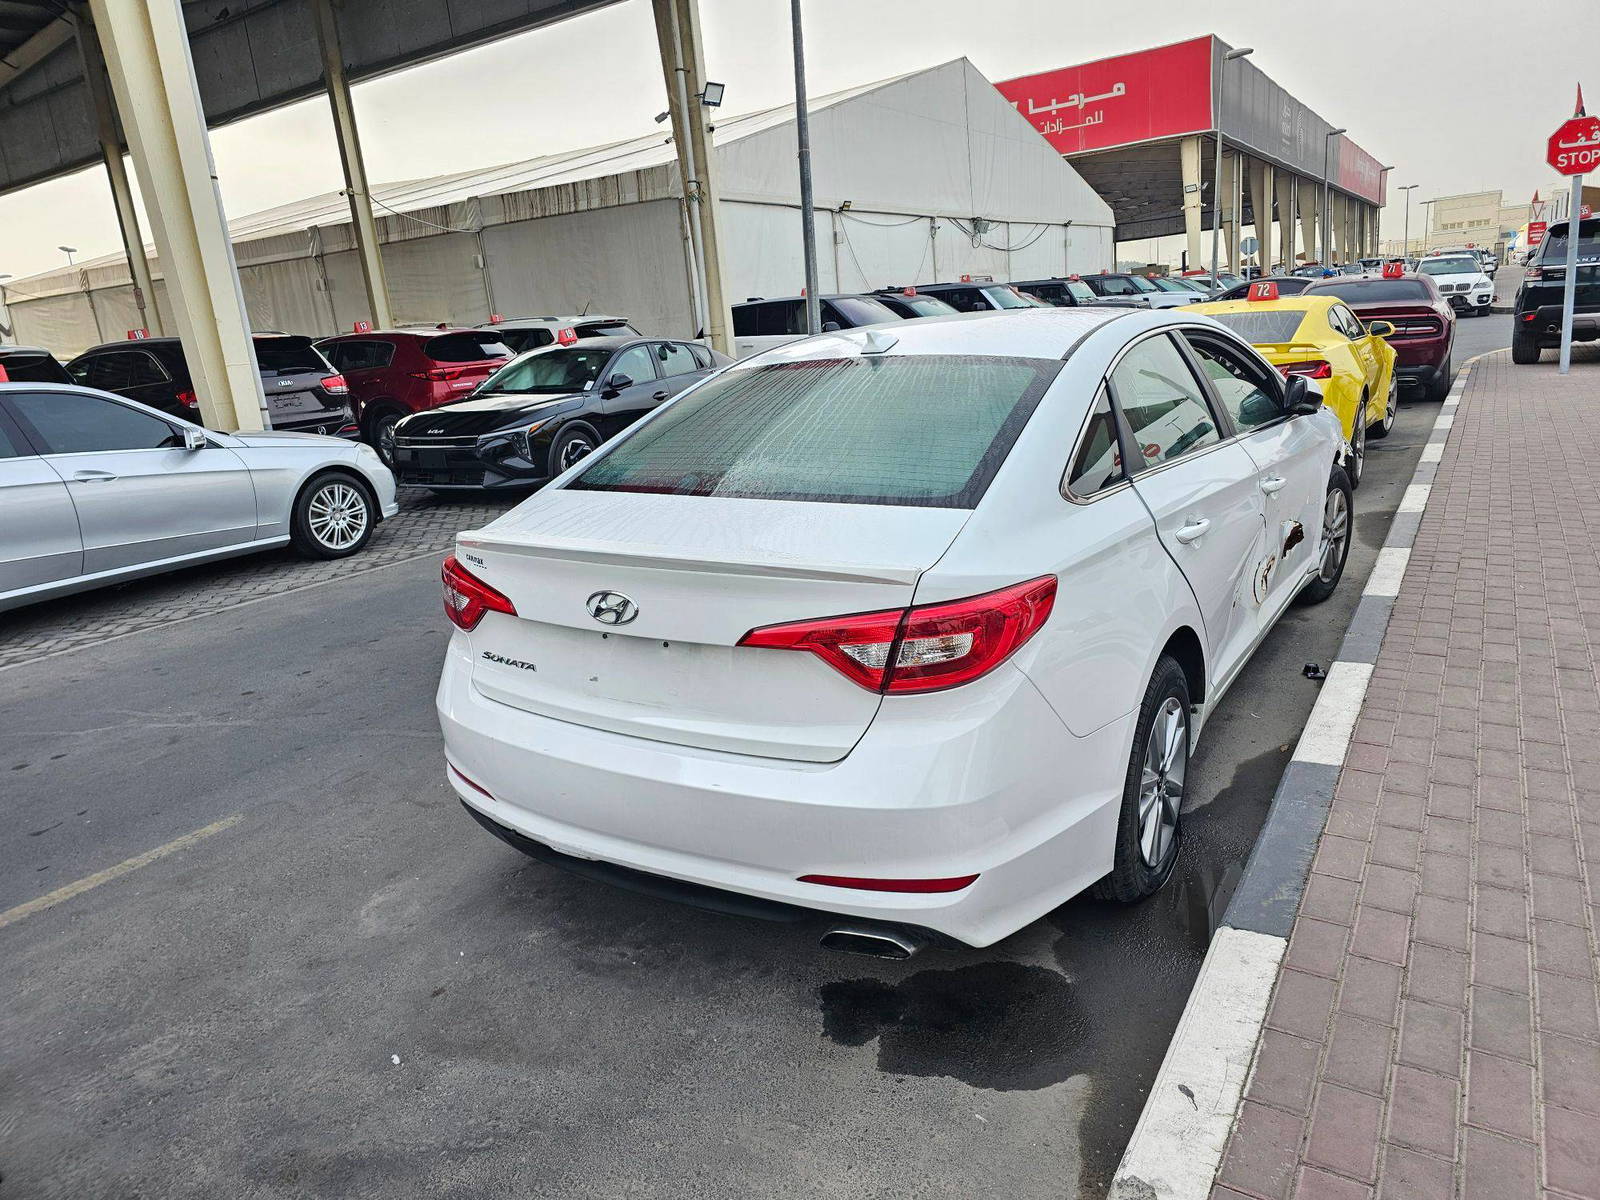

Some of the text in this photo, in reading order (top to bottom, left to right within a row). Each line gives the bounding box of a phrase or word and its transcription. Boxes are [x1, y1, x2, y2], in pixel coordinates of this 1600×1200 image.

[1558, 125, 1600, 149] قف
[1557, 149, 1600, 167] STOP
[1387, 264, 1396, 273] 71
[1257, 283, 1270, 297] 72
[481, 650, 537, 672] SONATA
